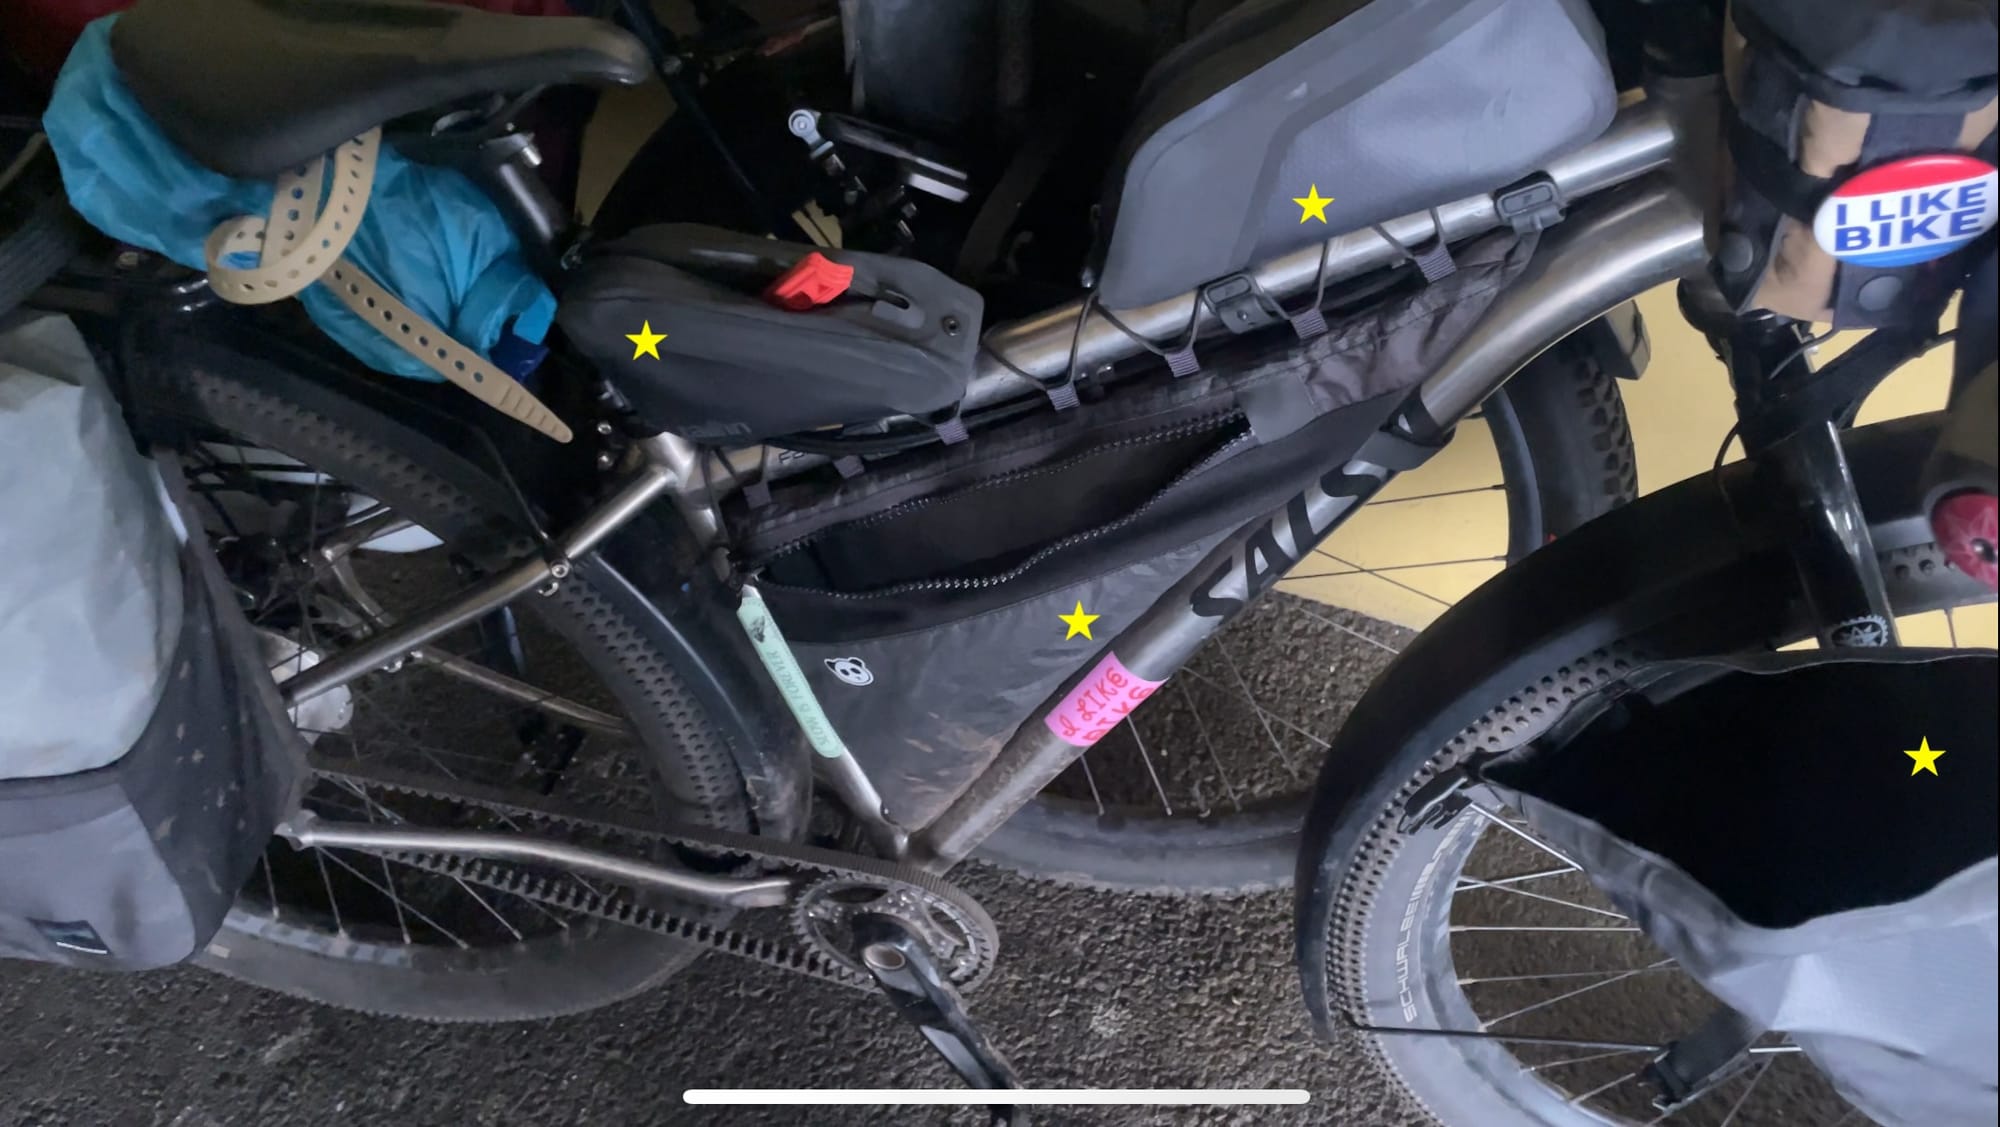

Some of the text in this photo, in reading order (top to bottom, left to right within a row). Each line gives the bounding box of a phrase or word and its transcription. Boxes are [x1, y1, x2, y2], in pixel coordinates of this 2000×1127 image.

[1836, 181, 1988, 226] I LIKE
[1834, 206, 1987, 251] BIKE
[766, 649, 804, 701] FOREVER
[1076, 666, 1129, 722] LIKE
[804, 714, 831, 746] SLOW
[1396, 900, 1420, 1024] SCHWALBE
